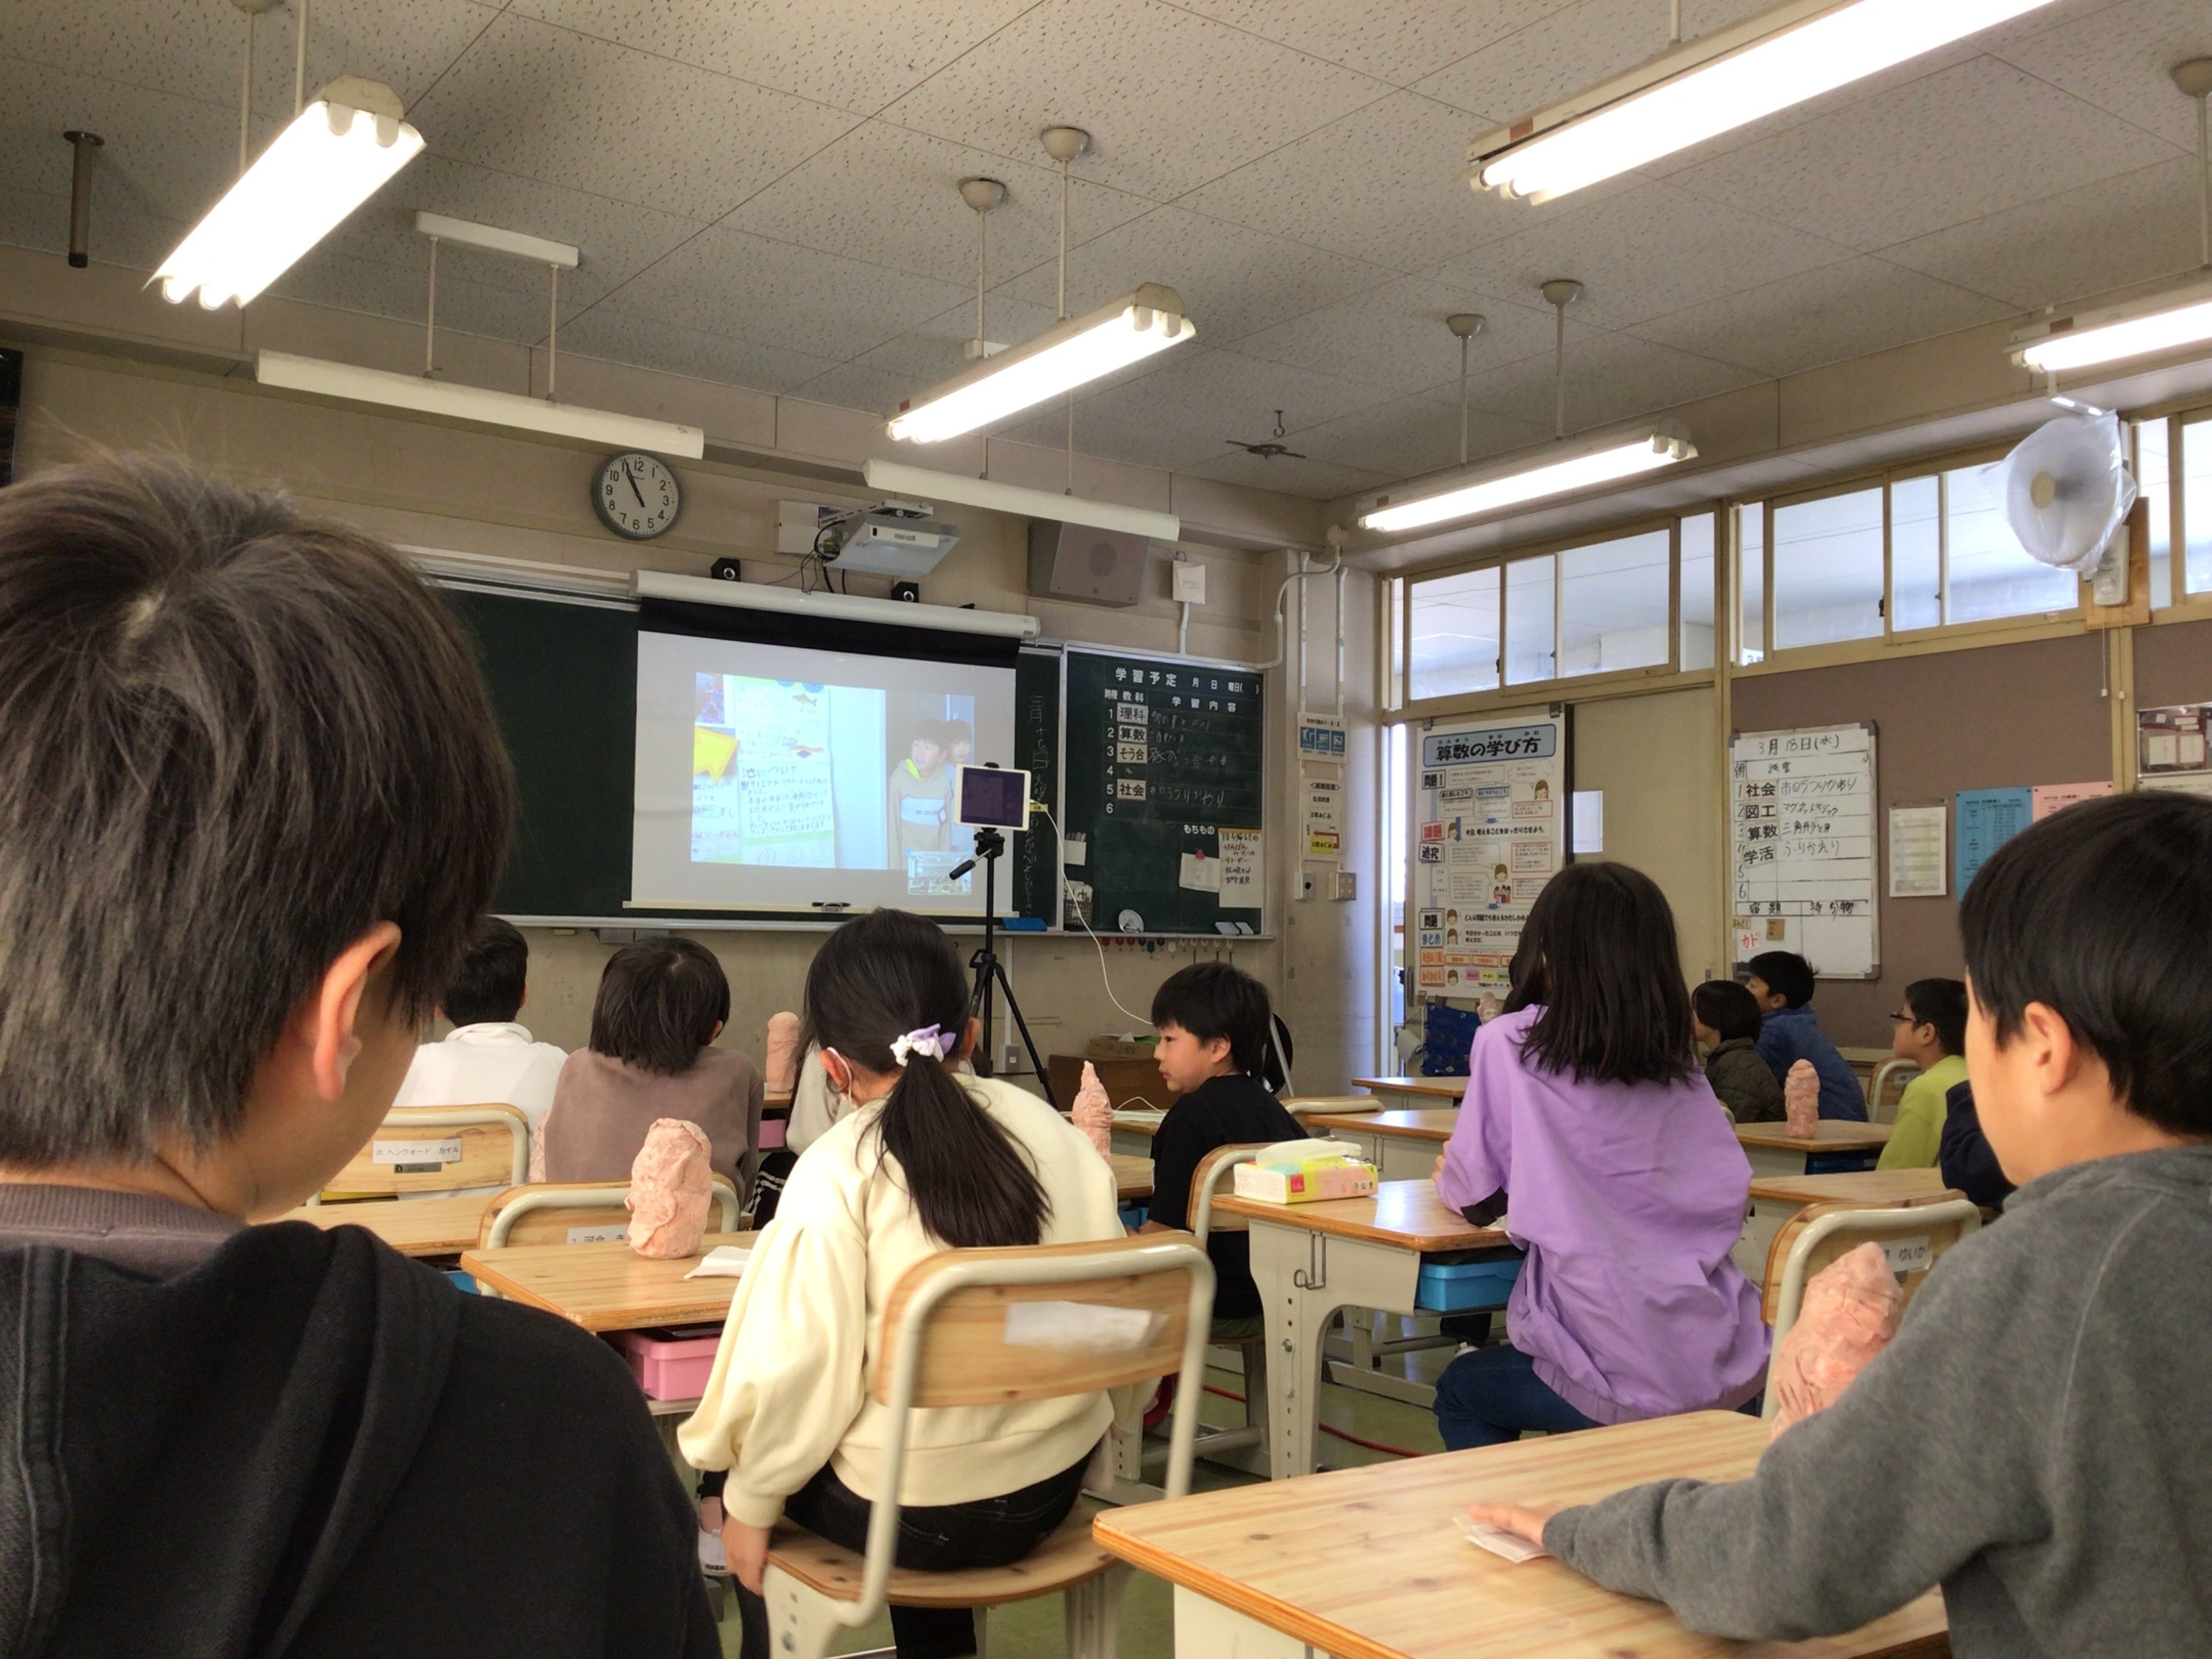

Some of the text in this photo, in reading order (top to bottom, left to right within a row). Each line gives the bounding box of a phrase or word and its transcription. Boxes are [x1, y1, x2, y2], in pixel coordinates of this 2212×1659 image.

[634, 460, 644, 472] 12
[610, 470, 619, 481] 10
[651, 468, 655, 478] 1
[606, 485, 613, 495] 9
[660, 480, 666, 491] 2
[609, 500, 615, 510] 8
[663, 495, 669, 506] 3
[619, 513, 627, 524] 7
[657, 510, 664, 519] 4
[633, 519, 640, 530] 6
[647, 518, 654, 529] 5
[1115, 668, 1176, 687] 学習予定
[1193, 678, 1200, 688] 月
[1211, 680, 1218, 690] 日
[1122, 691, 1144, 703] 教科
[1172, 696, 1237, 713] 学習内容
[1109, 708, 1145, 721] 1 理科
[1108, 728, 1145, 741] 2 算数
[1107, 746, 1145, 760] 3 そう合
[1436, 737, 1541, 760] 算数の学び方
[1106, 766, 1113, 775] 4
[1106, 783, 1145, 797] 5 社会
[1746, 782, 1776, 797] 社会
[1106, 803, 1113, 814] 6
[1746, 804, 1776, 819] 図工
[1183, 824, 1215, 835] もちもの
[1748, 824, 1778, 840] 算数
[1744, 846, 1774, 865] 学活
[1784, 840, 1839, 857] ふりかえり
[1738, 884, 1746, 899] 6
[1422, 934, 1440, 945] まとめ
